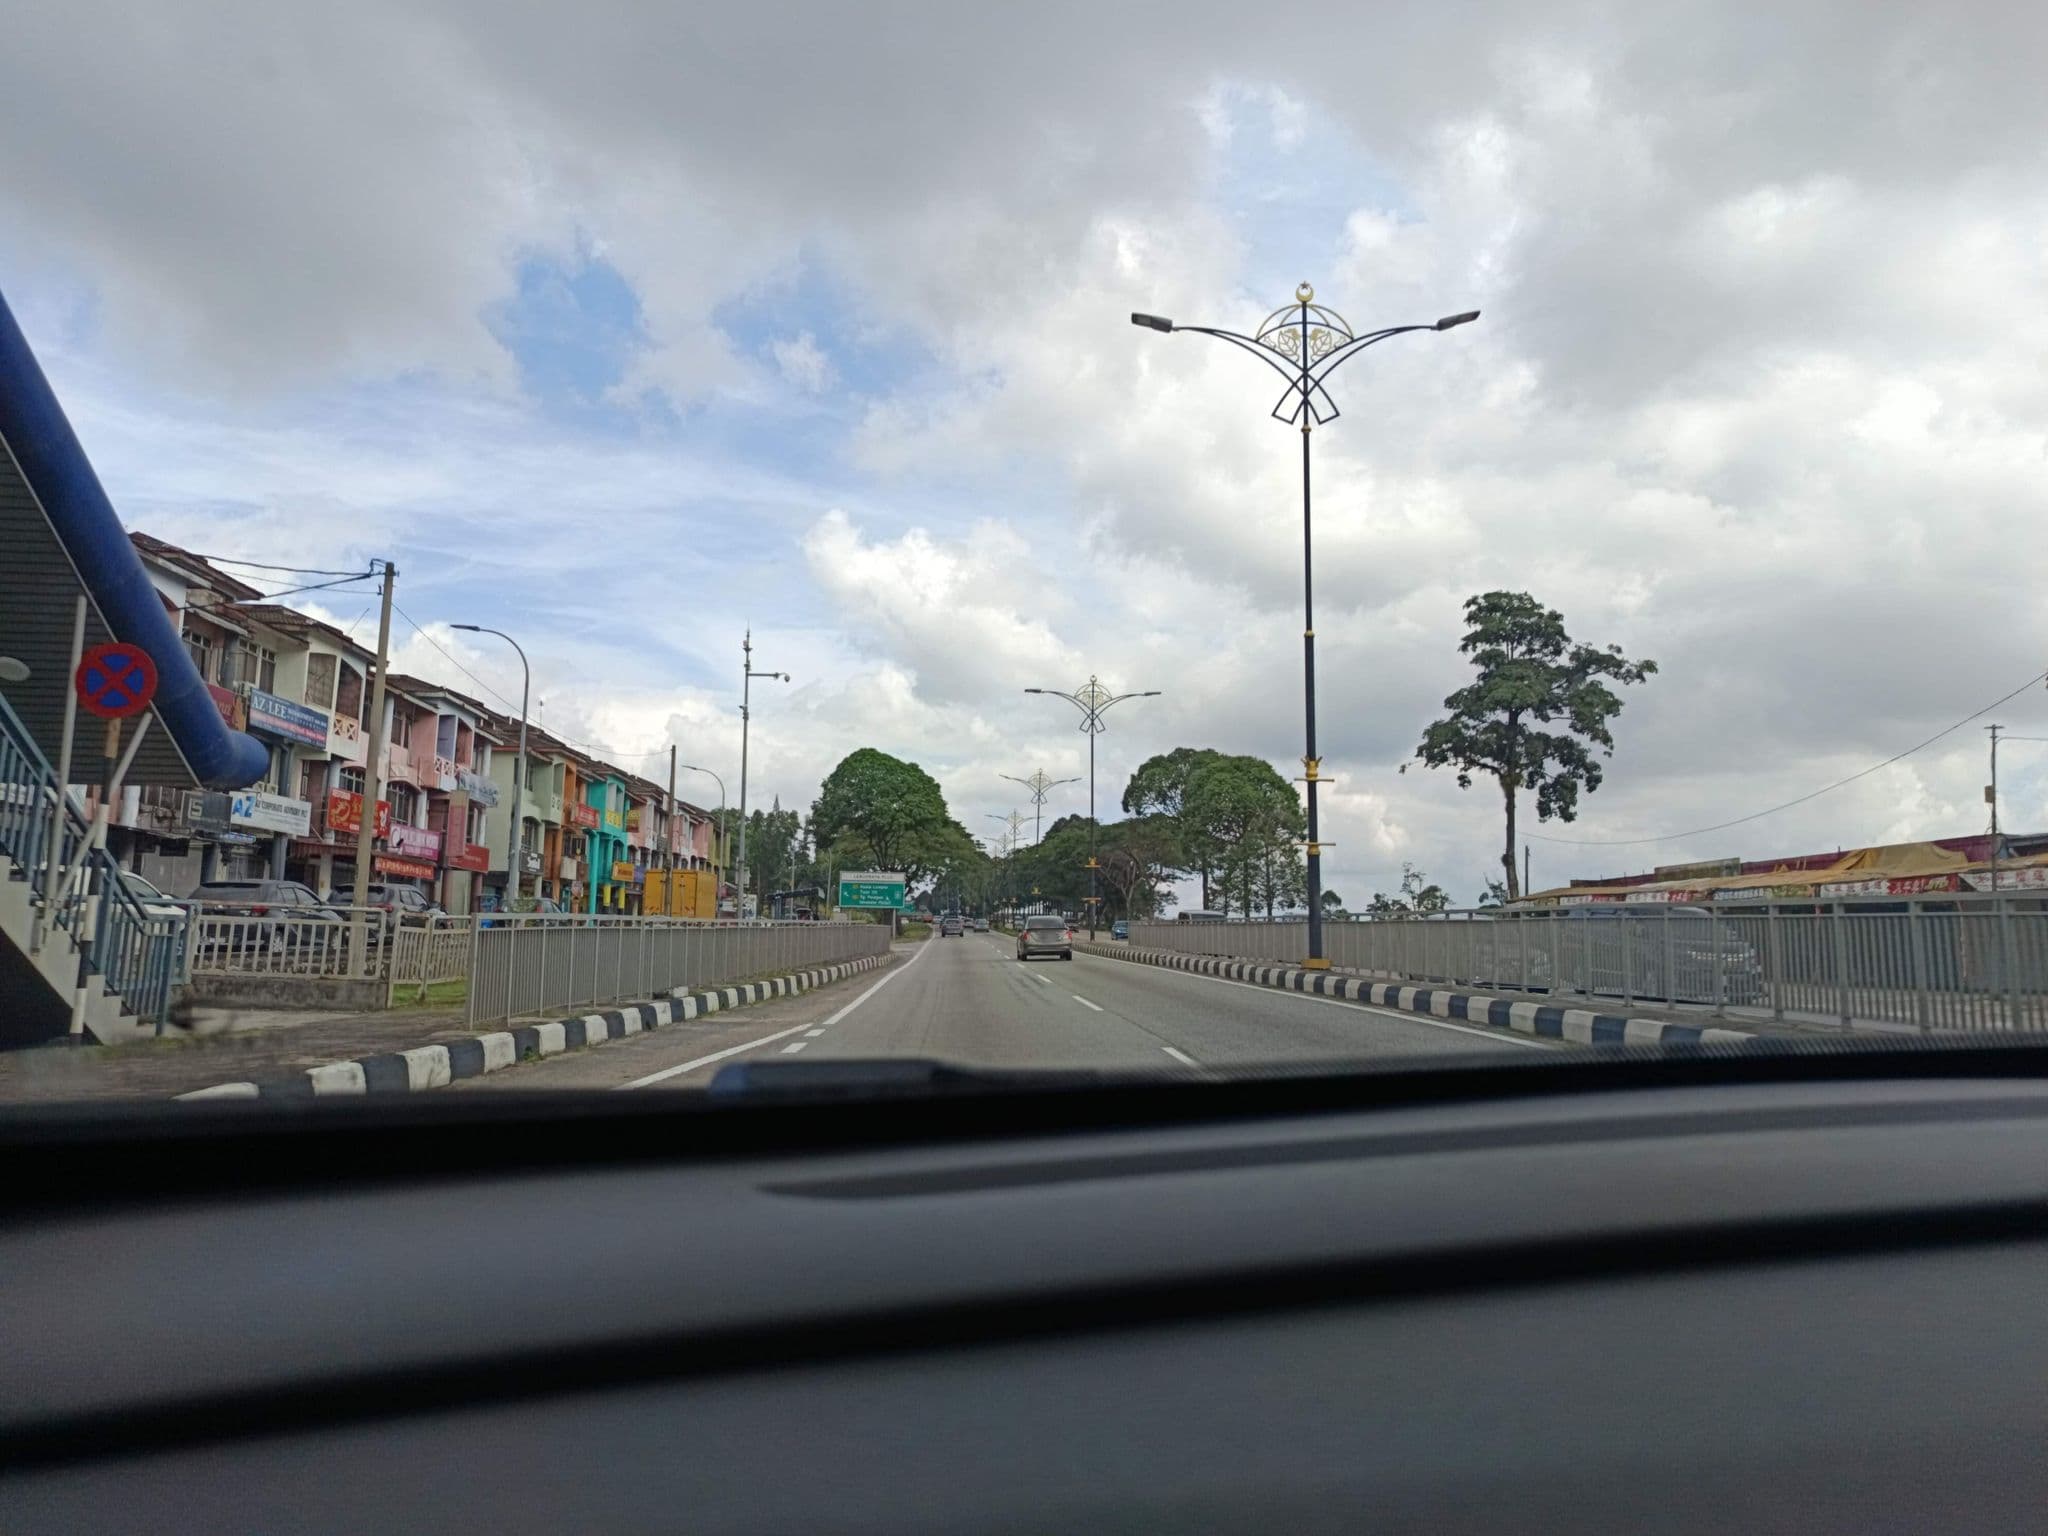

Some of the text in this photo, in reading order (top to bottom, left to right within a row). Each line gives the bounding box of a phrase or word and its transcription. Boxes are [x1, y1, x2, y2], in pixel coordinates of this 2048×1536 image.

[253, 695, 266, 711] AZ
[269, 700, 288, 718] LEE
[232, 796, 256, 817] AZ
